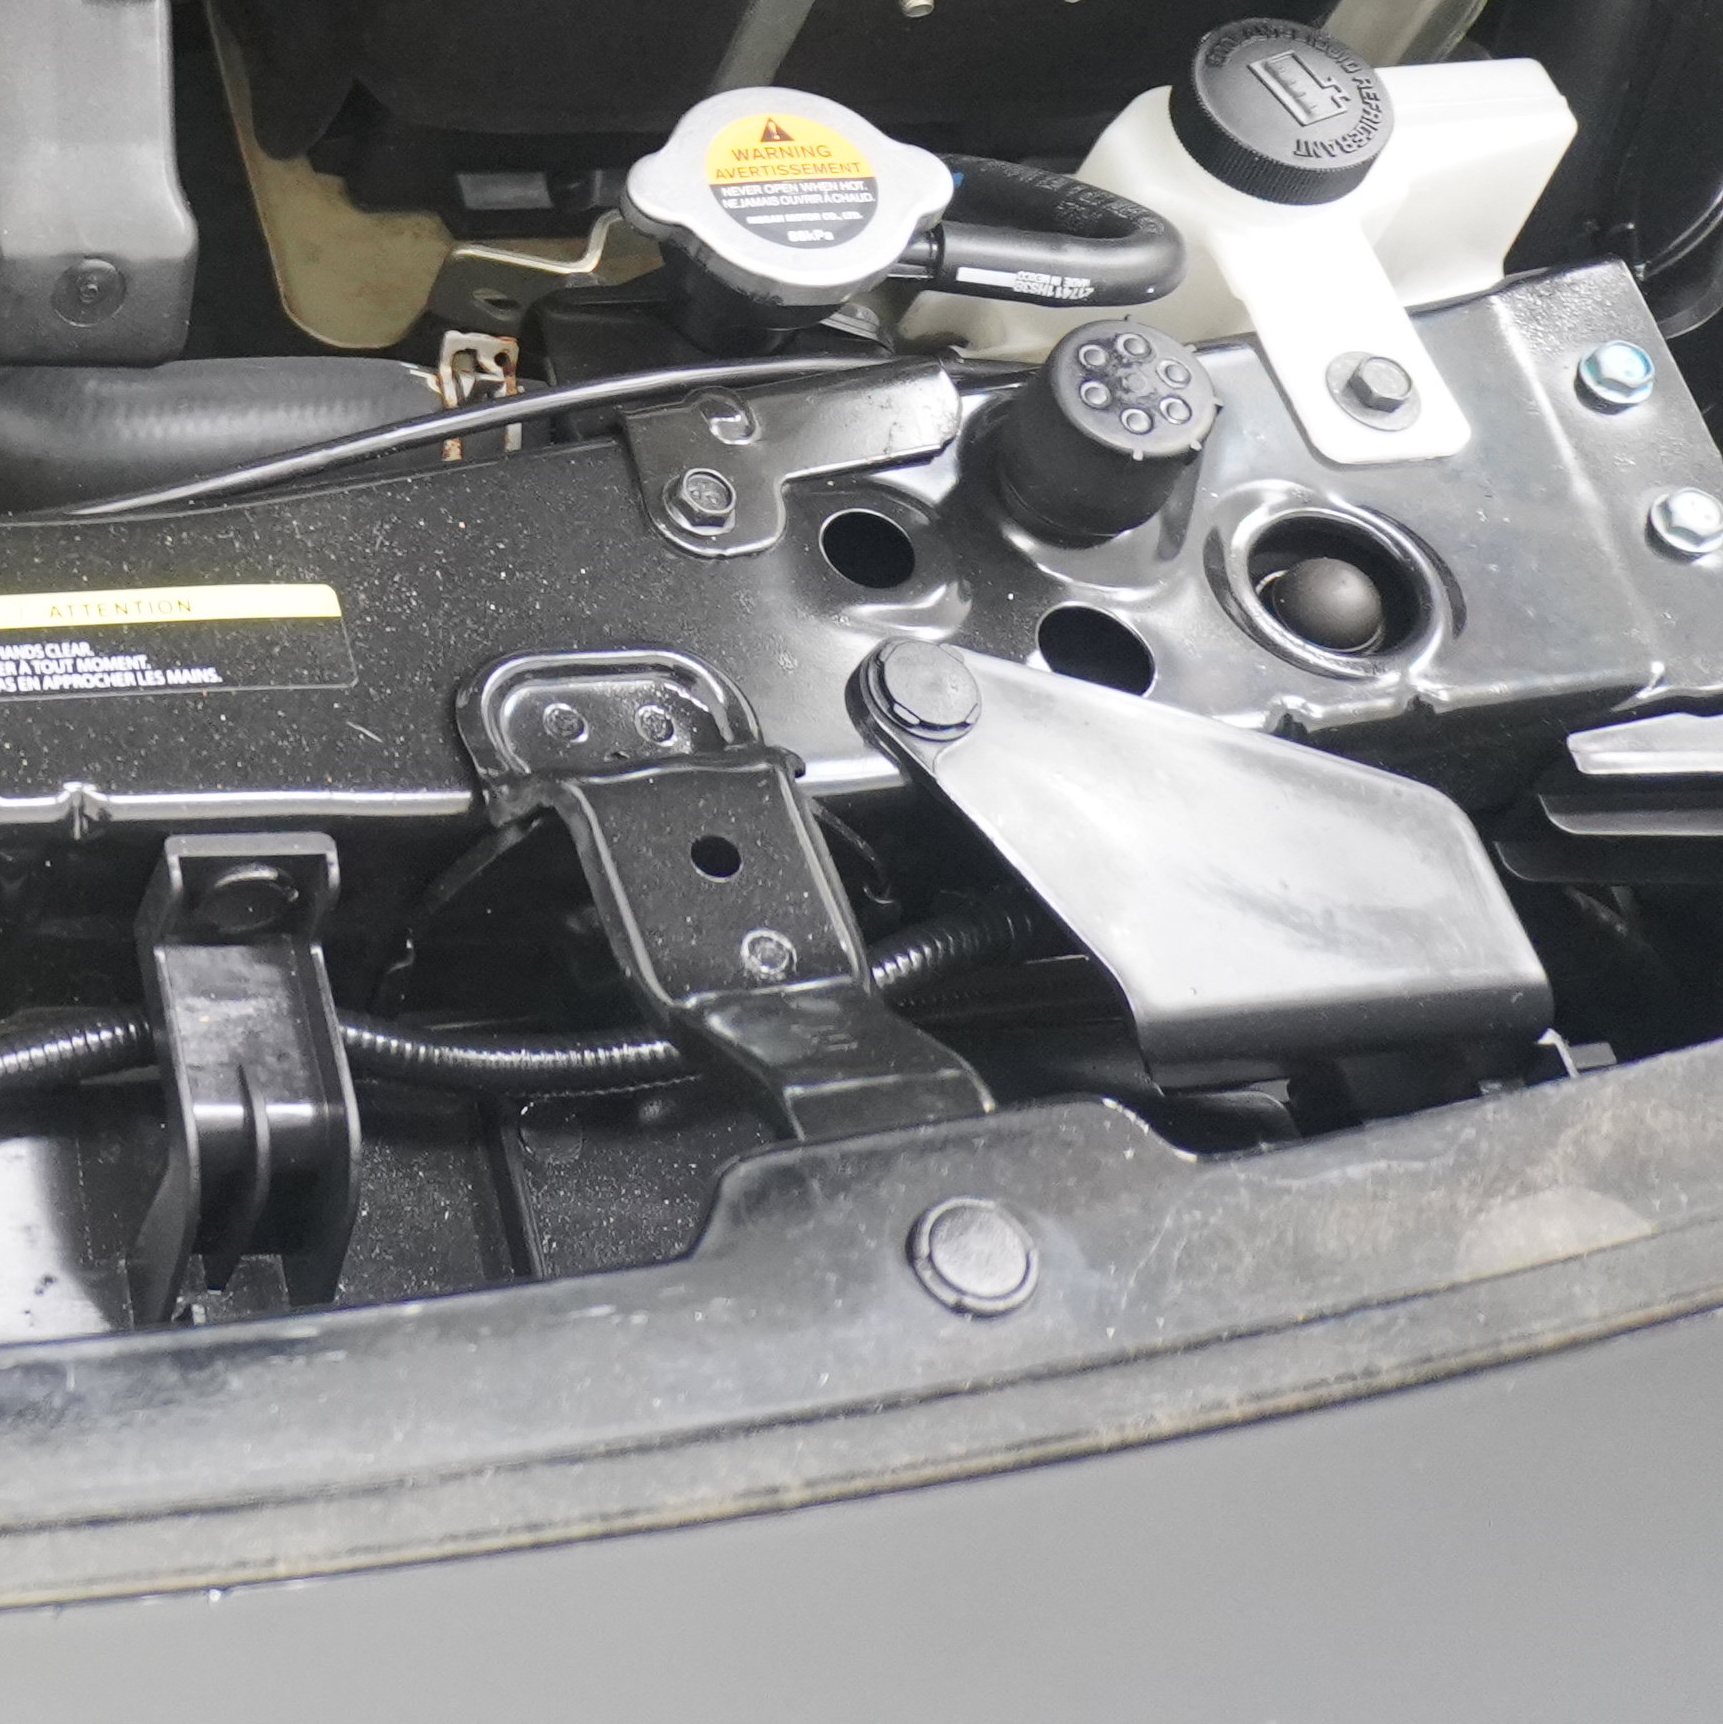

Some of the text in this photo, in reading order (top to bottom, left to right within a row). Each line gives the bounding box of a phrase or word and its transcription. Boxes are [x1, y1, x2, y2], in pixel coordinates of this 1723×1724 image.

[732, 145, 832, 161] WARNING
[715, 162, 861, 180] AVERTISSEMENT
[722, 181, 868, 196] NEVER OPEN WHEN HOT.
[739, 195, 779, 208] JAMAIS
[781, 194, 822, 205] OUVRIR
[831, 192, 875, 204] CHAUD.
[49, 599, 192, 619] ATTENTION
[45, 641, 94, 658] CLEAR.
[19, 658, 32, 675] À
[33, 658, 74, 674] TOUT
[76, 654, 151, 672] MOMENT.
[18, 676, 41, 691] EN
[42, 672, 136, 690] APPROCHER
[137, 670, 165, 686] LES
[166, 667, 223, 684] MAINS.
